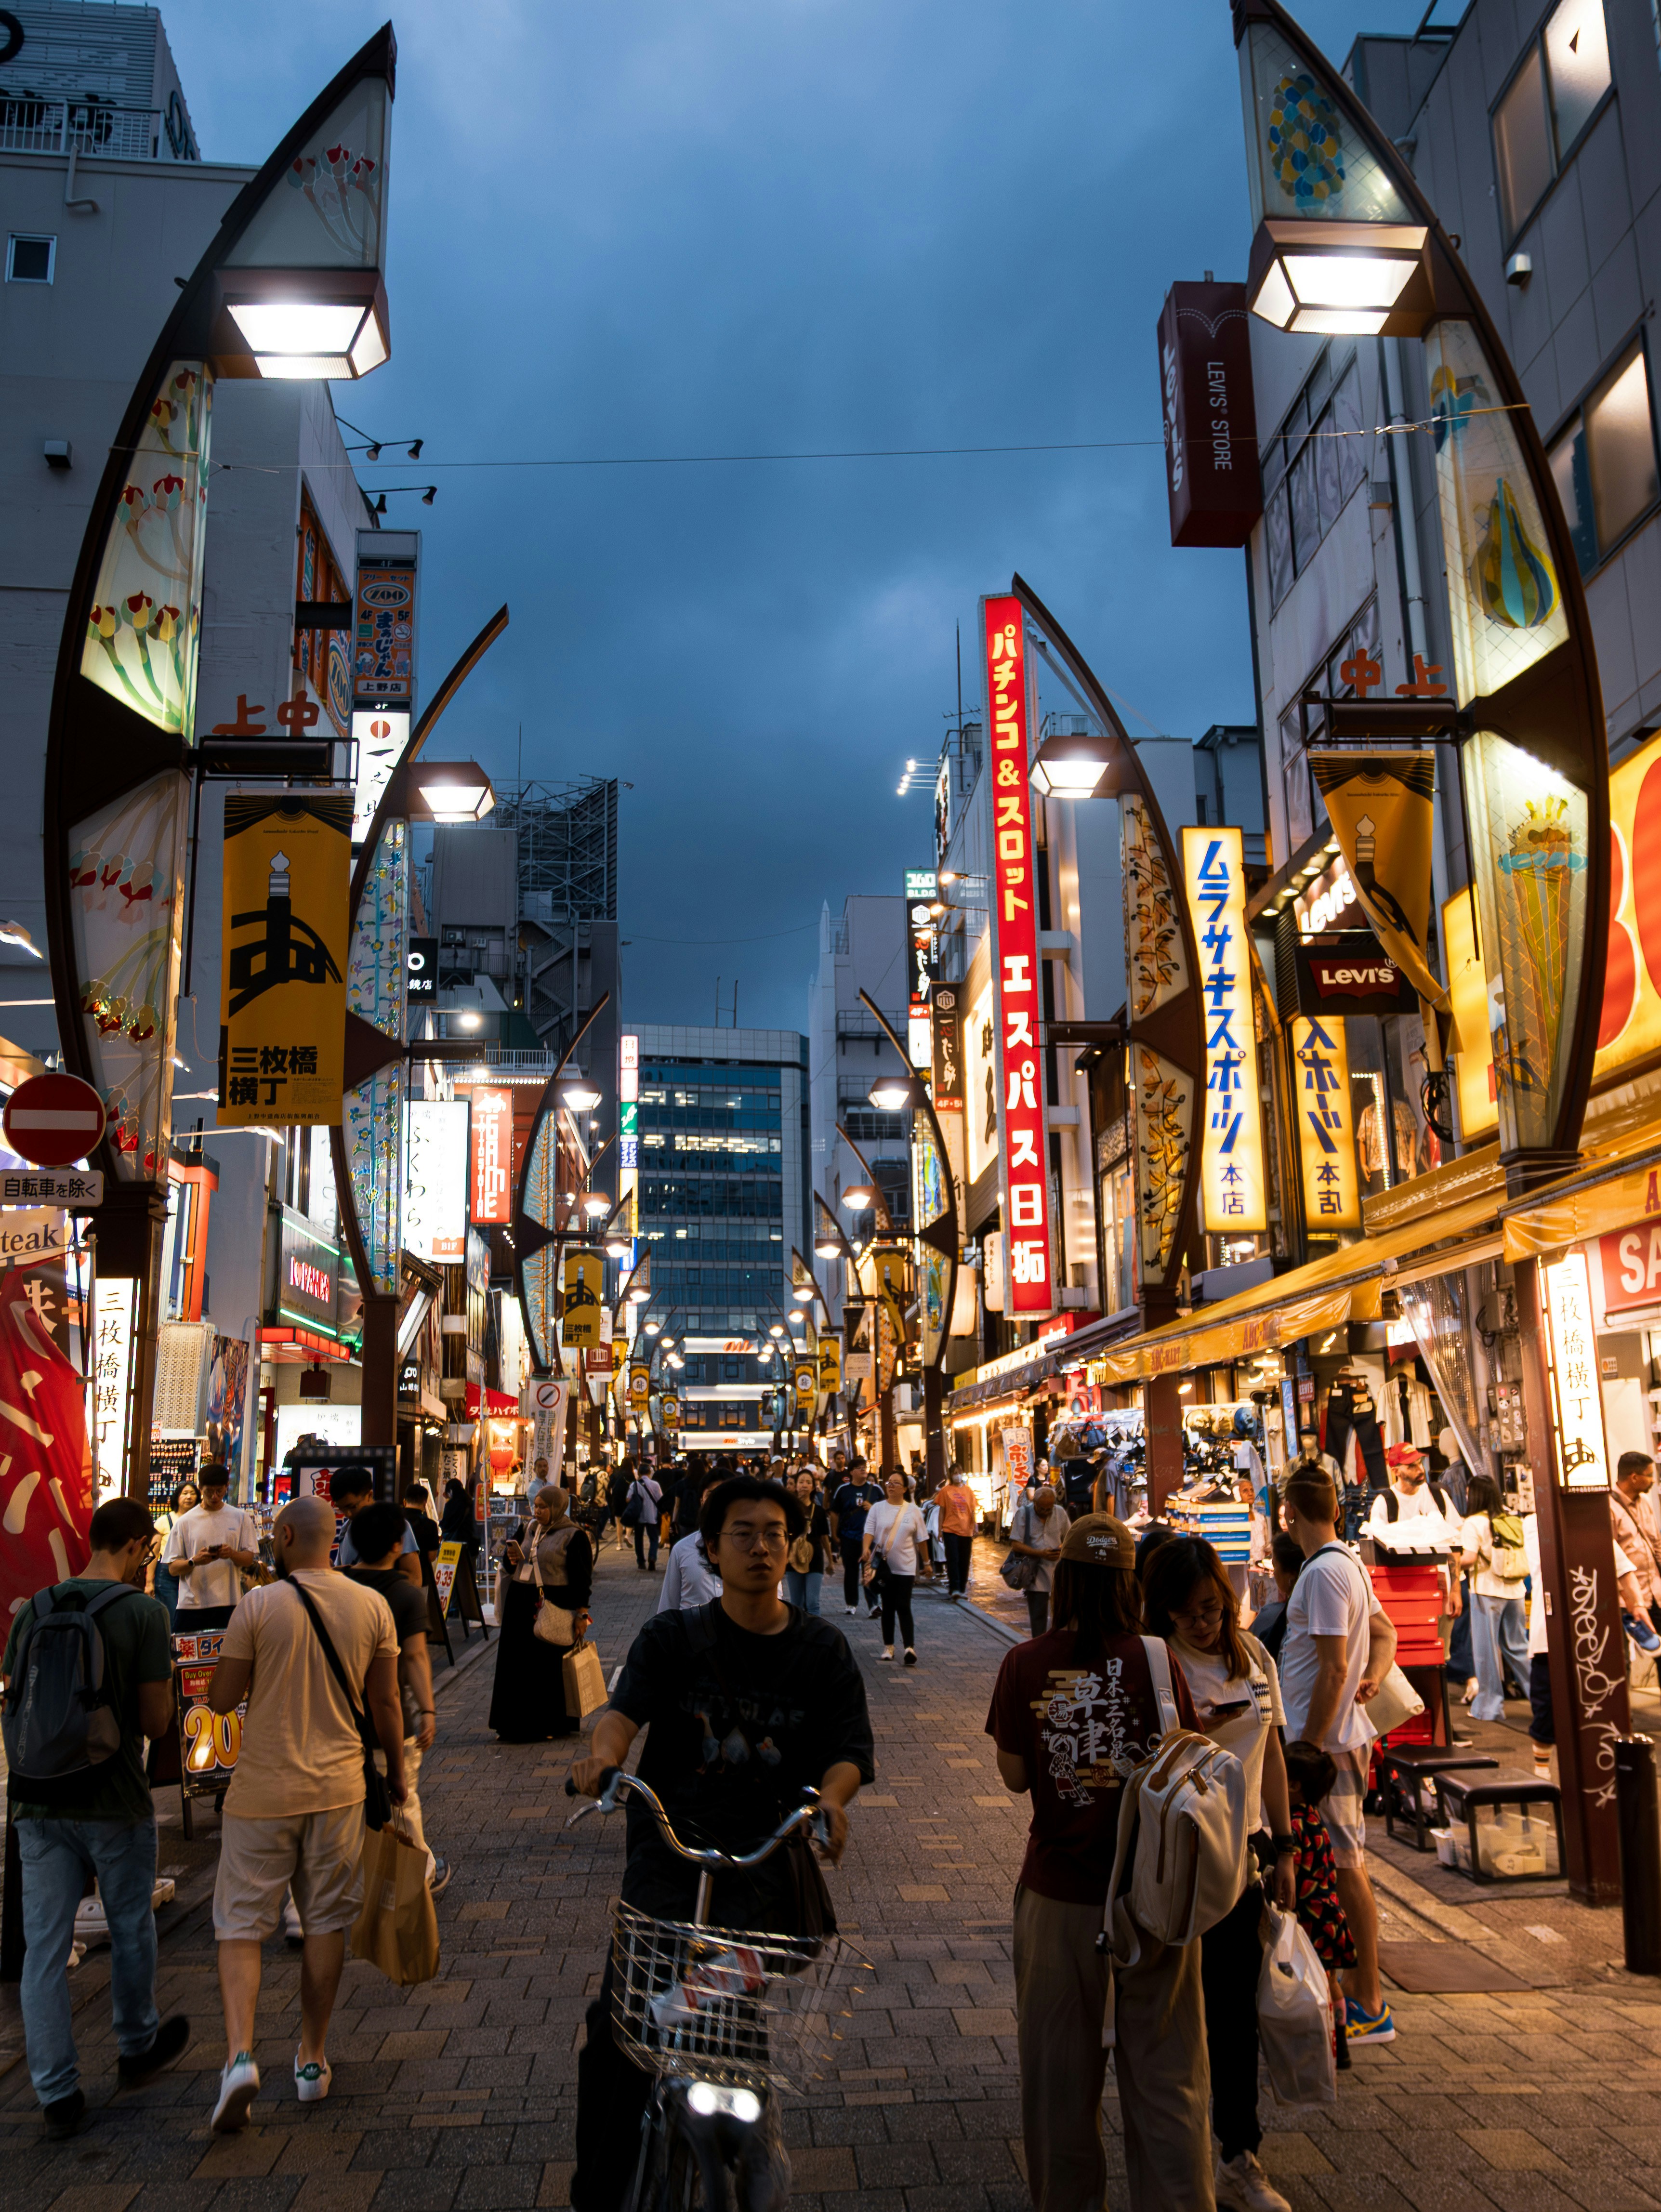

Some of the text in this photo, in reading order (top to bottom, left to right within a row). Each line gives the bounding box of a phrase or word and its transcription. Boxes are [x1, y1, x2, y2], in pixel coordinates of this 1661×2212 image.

[1163, 343, 1183, 492] Levi's
[1207, 361, 1232, 471] LEVI'S STORE
[360, 610, 373, 620] 4F
[369, 589, 404, 600] ZOO
[397, 611, 410, 621] 5F
[375, 611, 393, 678] まぁじゃん
[363, 683, 402, 692] 上野店
[992, 624, 1028, 921] パチンコ&スロット
[1322, 968, 1395, 985] Levi's
[230, 1045, 317, 1075] 三枚橋
[1197, 840, 1247, 1215] ムラサキスポーツ 本店
[229, 1077, 287, 1106] 横丁
[4, 1177, 96, 1198] 自転車を除く
[403, 1126, 429, 1249] ふくわらい
[484, 1114, 505, 1218] GAME
[0, 1223, 60, 1253] teak
[96, 1292, 125, 1443] 三枚橋横丁
[1556, 1267, 1591, 1422] 三枚橋横丁
[1086, 1535, 1118, 1547] Dodgers
[1065, 1672, 1109, 1764] 草津
[1106, 1657, 1127, 1759] 日本三名泉
